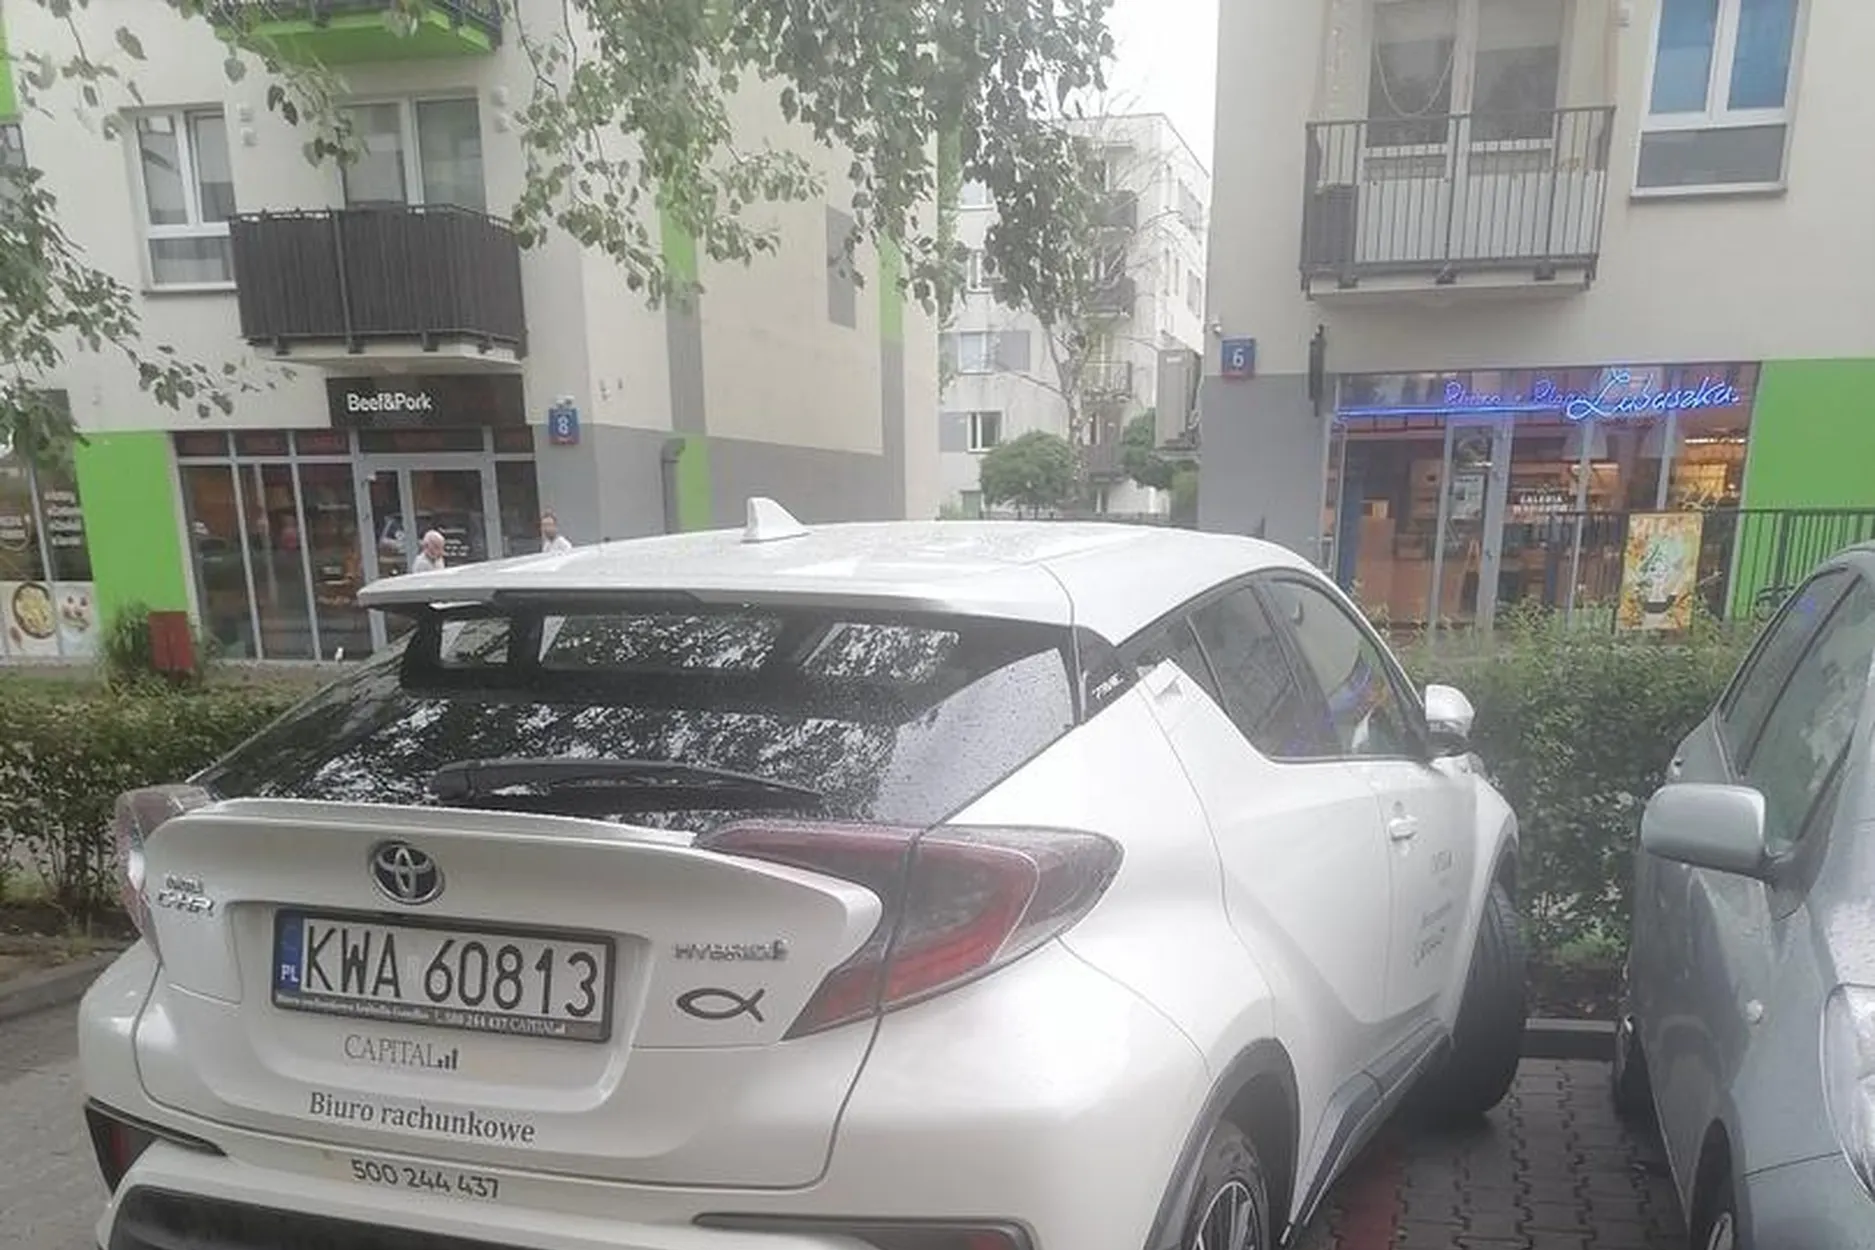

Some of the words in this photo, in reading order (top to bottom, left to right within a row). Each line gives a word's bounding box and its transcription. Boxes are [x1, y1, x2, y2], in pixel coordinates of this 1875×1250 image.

[1232, 347, 1244, 367] 6
[346, 393, 432, 412] Beef&Pork
[557, 415, 569, 434] 8
[280, 963, 299, 982] PL
[306, 925, 401, 998] KWA
[424, 939, 598, 1018] 60813
[344, 1034, 438, 1068] CAPITAL
[309, 1091, 374, 1121] Biuro
[380, 1105, 535, 1144] rachunkowe
[350, 1159, 398, 1185] 500
[403, 1167, 453, 1192] 244
[458, 1173, 499, 1198] 437
